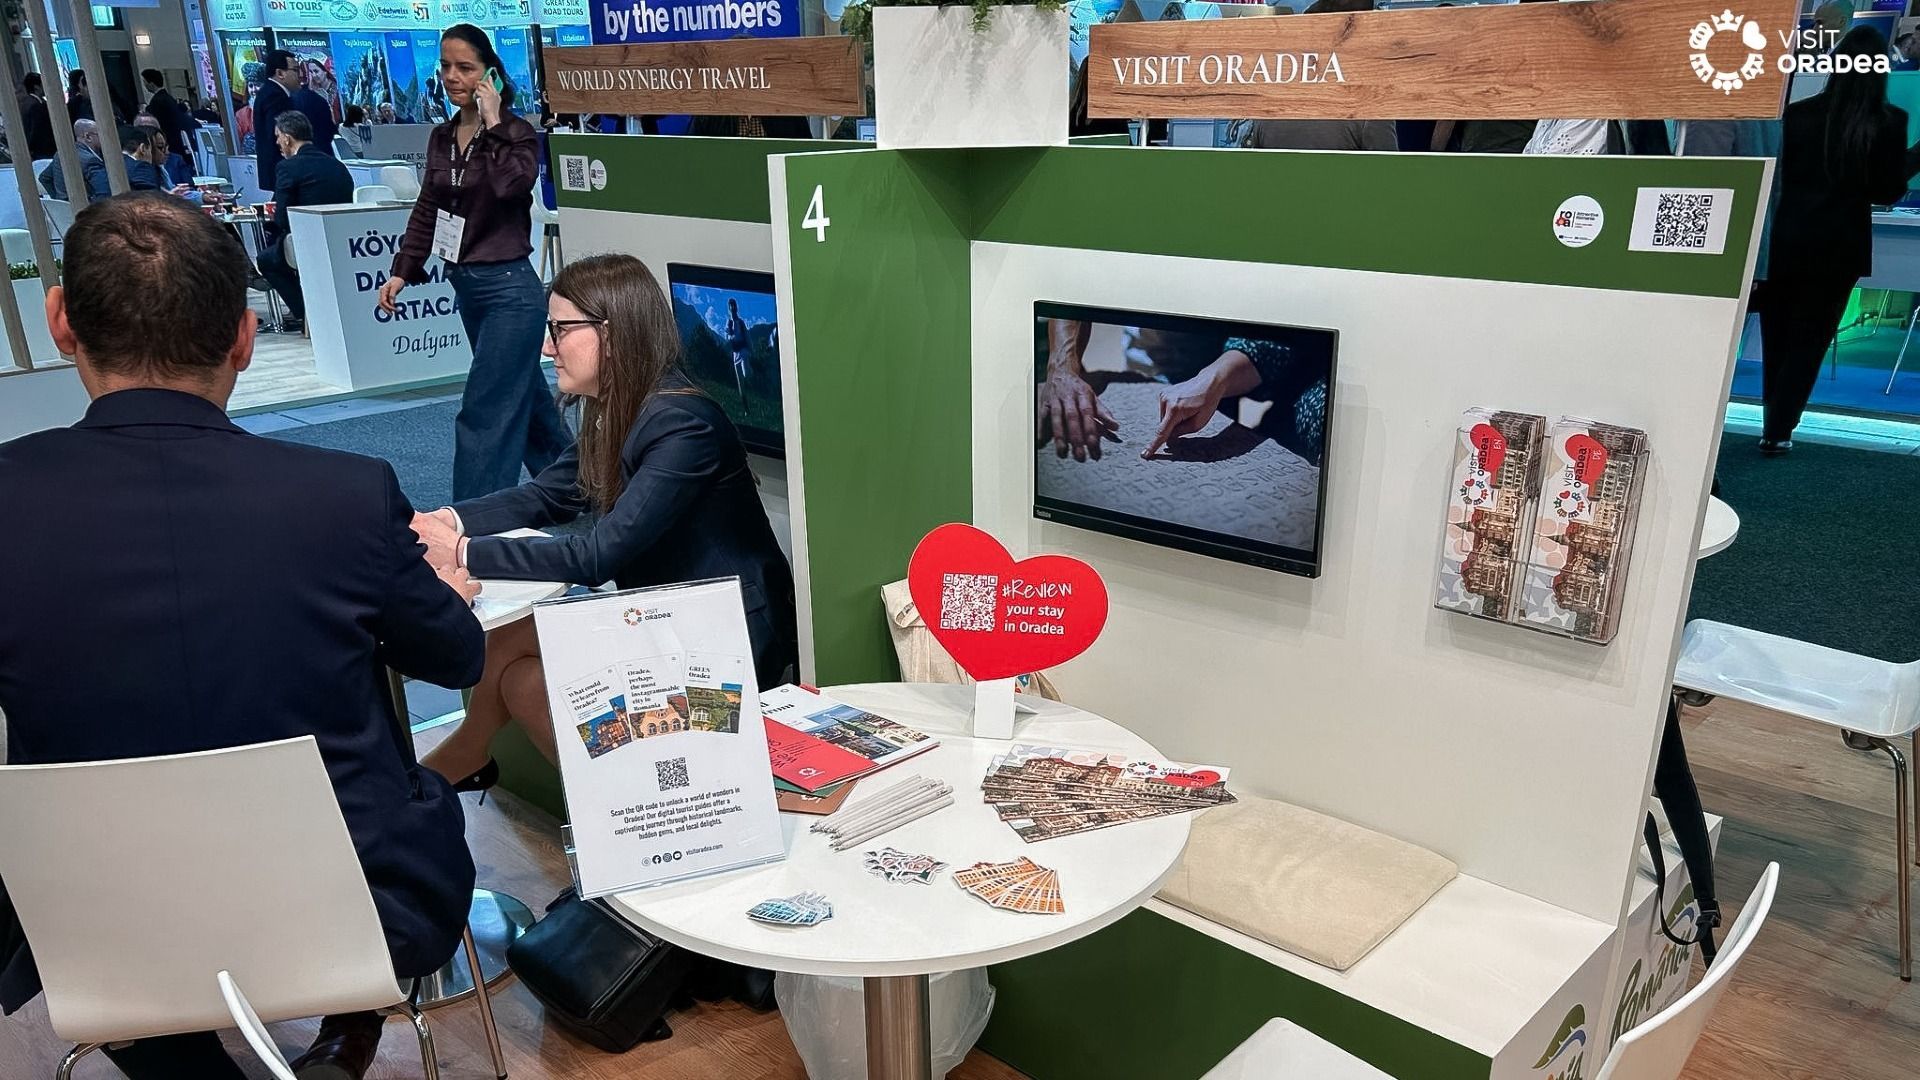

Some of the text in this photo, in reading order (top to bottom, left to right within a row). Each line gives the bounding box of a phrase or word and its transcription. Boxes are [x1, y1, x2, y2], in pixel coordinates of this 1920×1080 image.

[291, 1, 322, 11] TOURS
[378, 7, 409, 15] Edelweiss
[543, 8, 584, 16] ROAD TOURS
[603, 0, 782, 41] by the numbers
[225, 39, 267, 47] Turkmenista
[282, 38, 327, 47] Turkmenistan
[1112, 52, 1346, 85] VISIT ORADEA
[557, 66, 771, 90] WORLD SYNERGY TRAVEL
[392, 152, 428, 161] GREAT SIL
[802, 184, 830, 242] 4
[392, 329, 461, 358] Dalyan
[1493, 439, 1502, 450] EN
[1592, 449, 1602, 460] DE
[1469, 453, 1478, 475] VISIT
[1563, 464, 1575, 486] VISIT
[1001, 578, 1072, 599] #Review
[1006, 605, 1065, 620] your stay
[1004, 620, 1064, 635] in Oradea
[568, 680, 601, 698] What could
[579, 692, 595, 703] learn
[595, 685, 610, 696] from
[574, 697, 598, 711] Oradea?
[634, 703, 661, 711] Romania
[610, 809, 625, 817] Scan
[625, 806, 635, 814] the
[635, 804, 644, 813] QR
[645, 802, 658, 810] code
[666, 797, 684, 806] unlock
[690, 793, 704, 802] world
[712, 788, 734, 798] wonders
[624, 813, 645, 824] Oradea!
[646, 812, 656, 820] Our
[657, 808, 675, 818] digital
[676, 805, 694, 814] tourist
[695, 801, 712, 811] guides
[713, 799, 725, 807] offer
[614, 804, 743, 836] captivating journey through historical landmarks,
[638, 818, 722, 840] hidden gems, and local delights.
[686, 843, 723, 856] visitoradea.com
